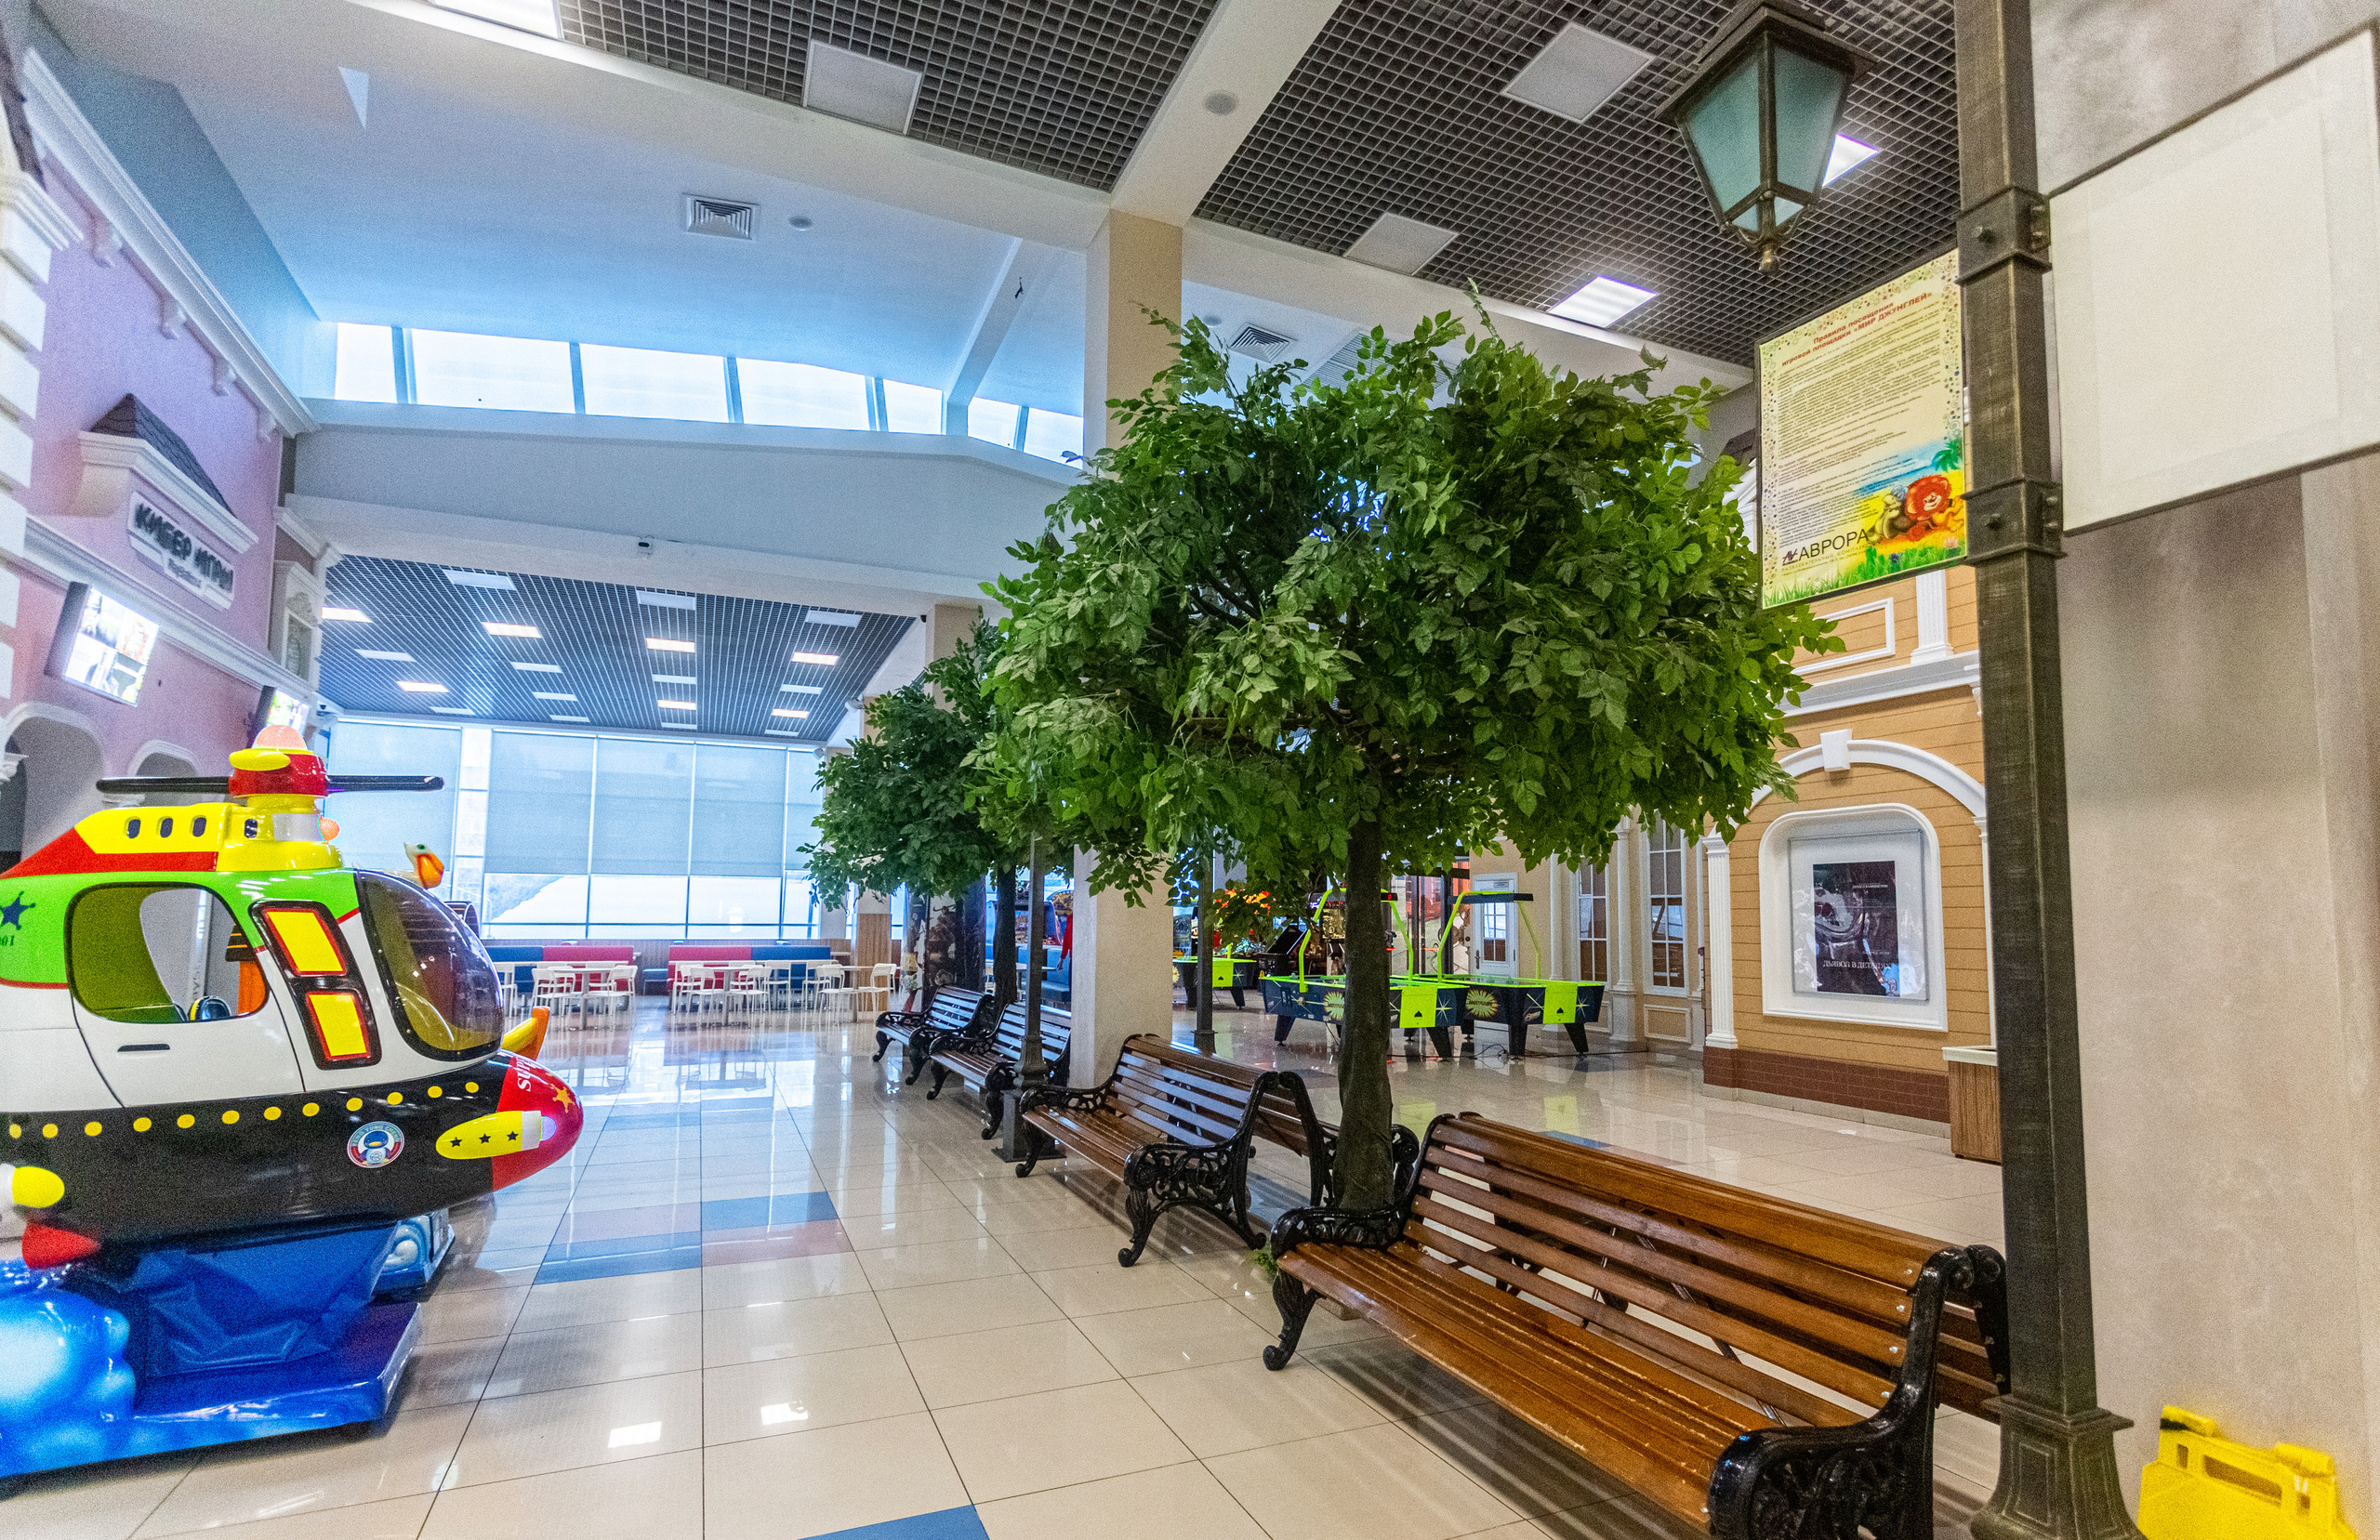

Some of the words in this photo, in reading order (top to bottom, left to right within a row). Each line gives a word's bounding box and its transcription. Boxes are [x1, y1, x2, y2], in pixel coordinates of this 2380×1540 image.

[1781, 349, 1811, 367] игровой
[1812, 330, 1851, 352] площадки
[1853, 316, 1876, 333] «МИР
[1877, 292, 1933, 322] ДЖУНГЛЕЙ»
[1813, 324, 1846, 344] Правила
[1847, 302, 1894, 326] посещения
[1798, 528, 1870, 561] АВРОРА
[0, 935, 15, 946] 01
[1822, 960, 1851, 968] ДЬЯВОЛ
